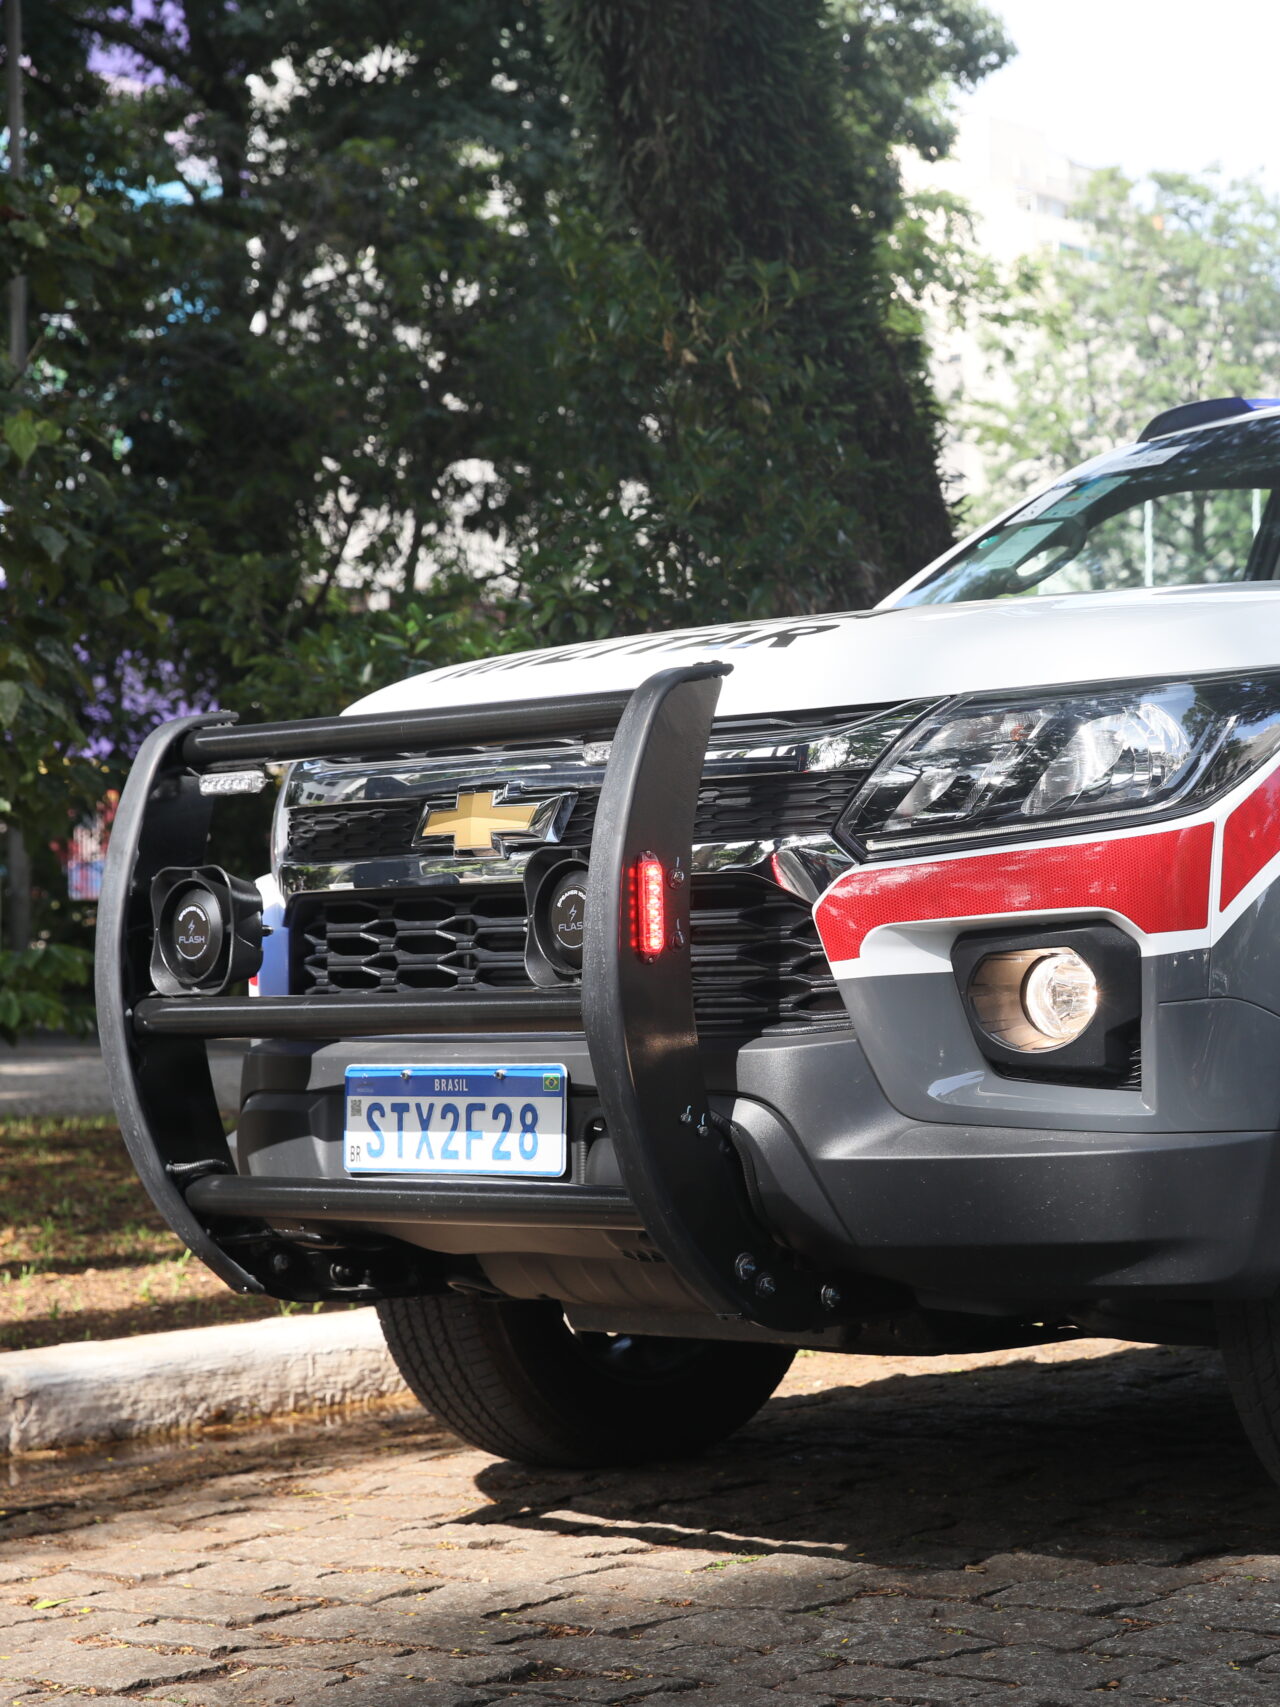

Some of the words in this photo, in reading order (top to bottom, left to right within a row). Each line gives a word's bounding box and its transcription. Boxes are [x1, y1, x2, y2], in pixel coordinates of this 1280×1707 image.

[558, 921, 583, 932] FLAS
[178, 935, 205, 944] FLASH
[434, 1078, 468, 1092] BRASIL
[366, 1102, 539, 1161] STX2F28
[350, 1145, 361, 1162] BR
